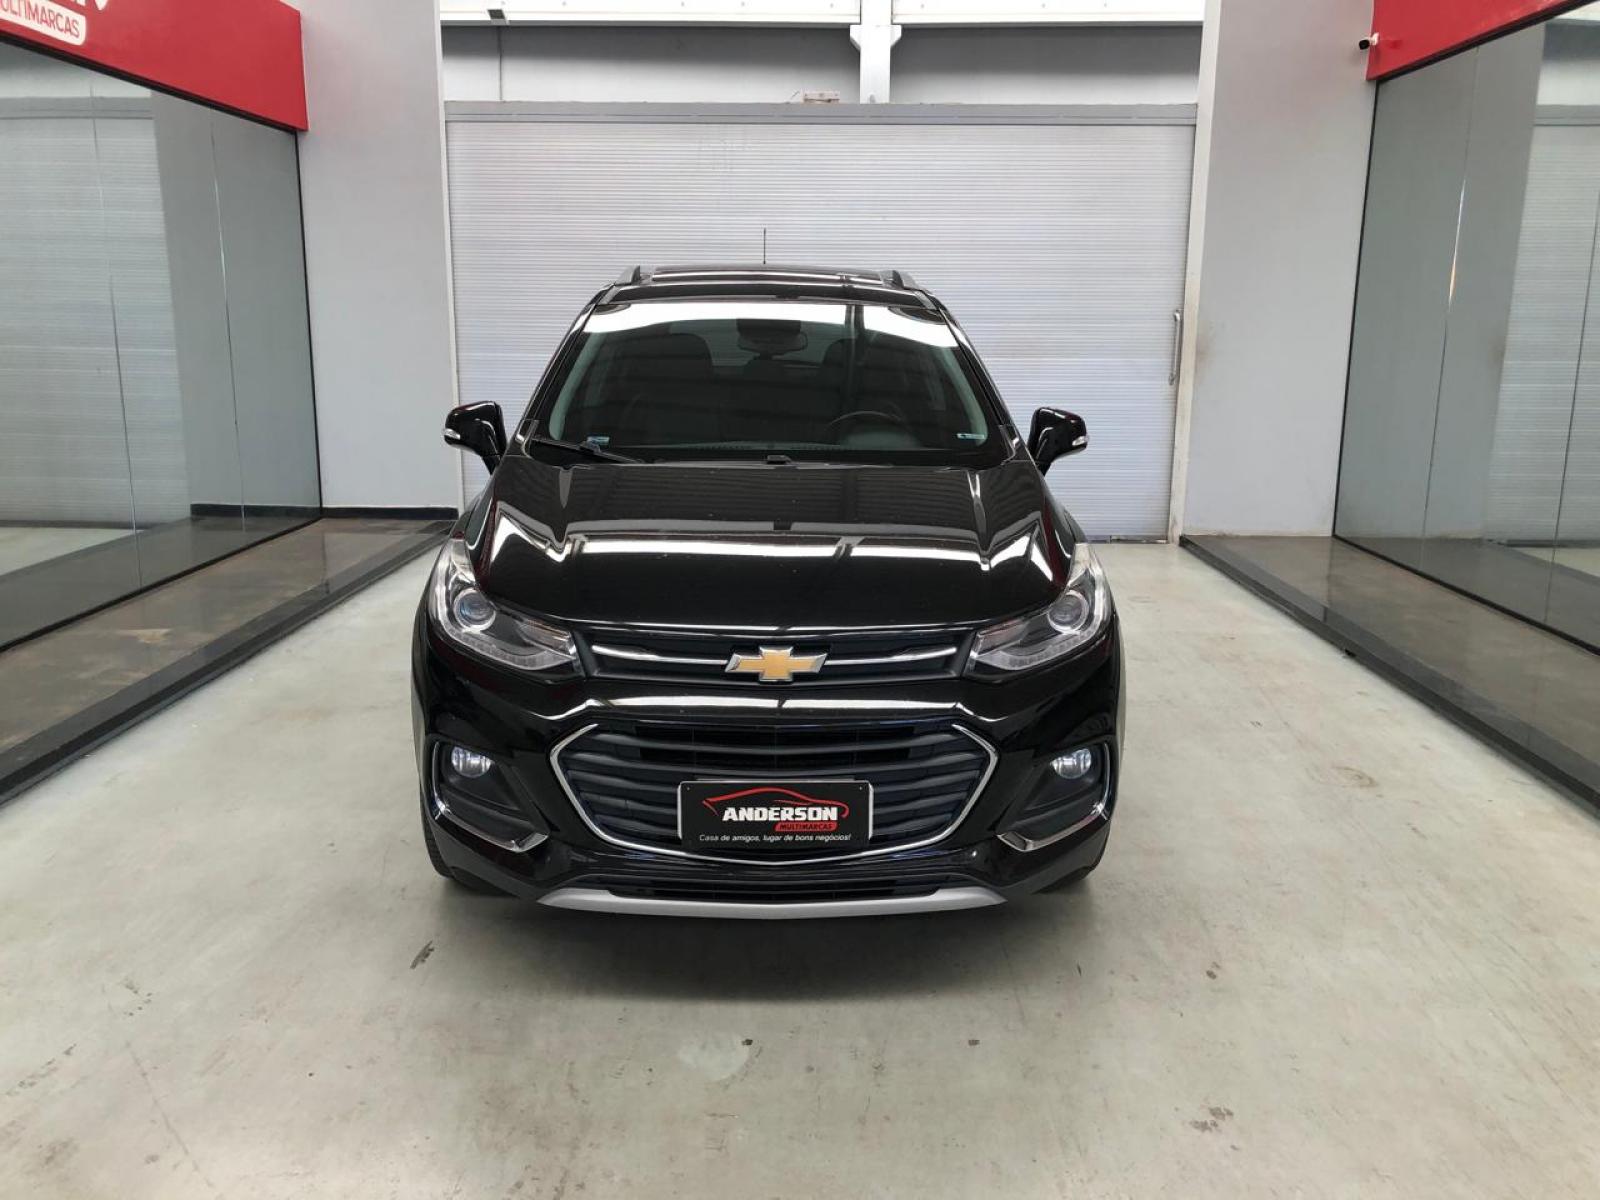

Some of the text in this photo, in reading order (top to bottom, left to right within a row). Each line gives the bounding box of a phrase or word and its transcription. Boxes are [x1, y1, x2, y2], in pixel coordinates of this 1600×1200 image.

[0, 0, 79, 38] ULTIMARCAS
[721, 806, 838, 821] ANDERSON
[731, 834, 760, 843] amigos,
[763, 834, 782, 843] lugar
